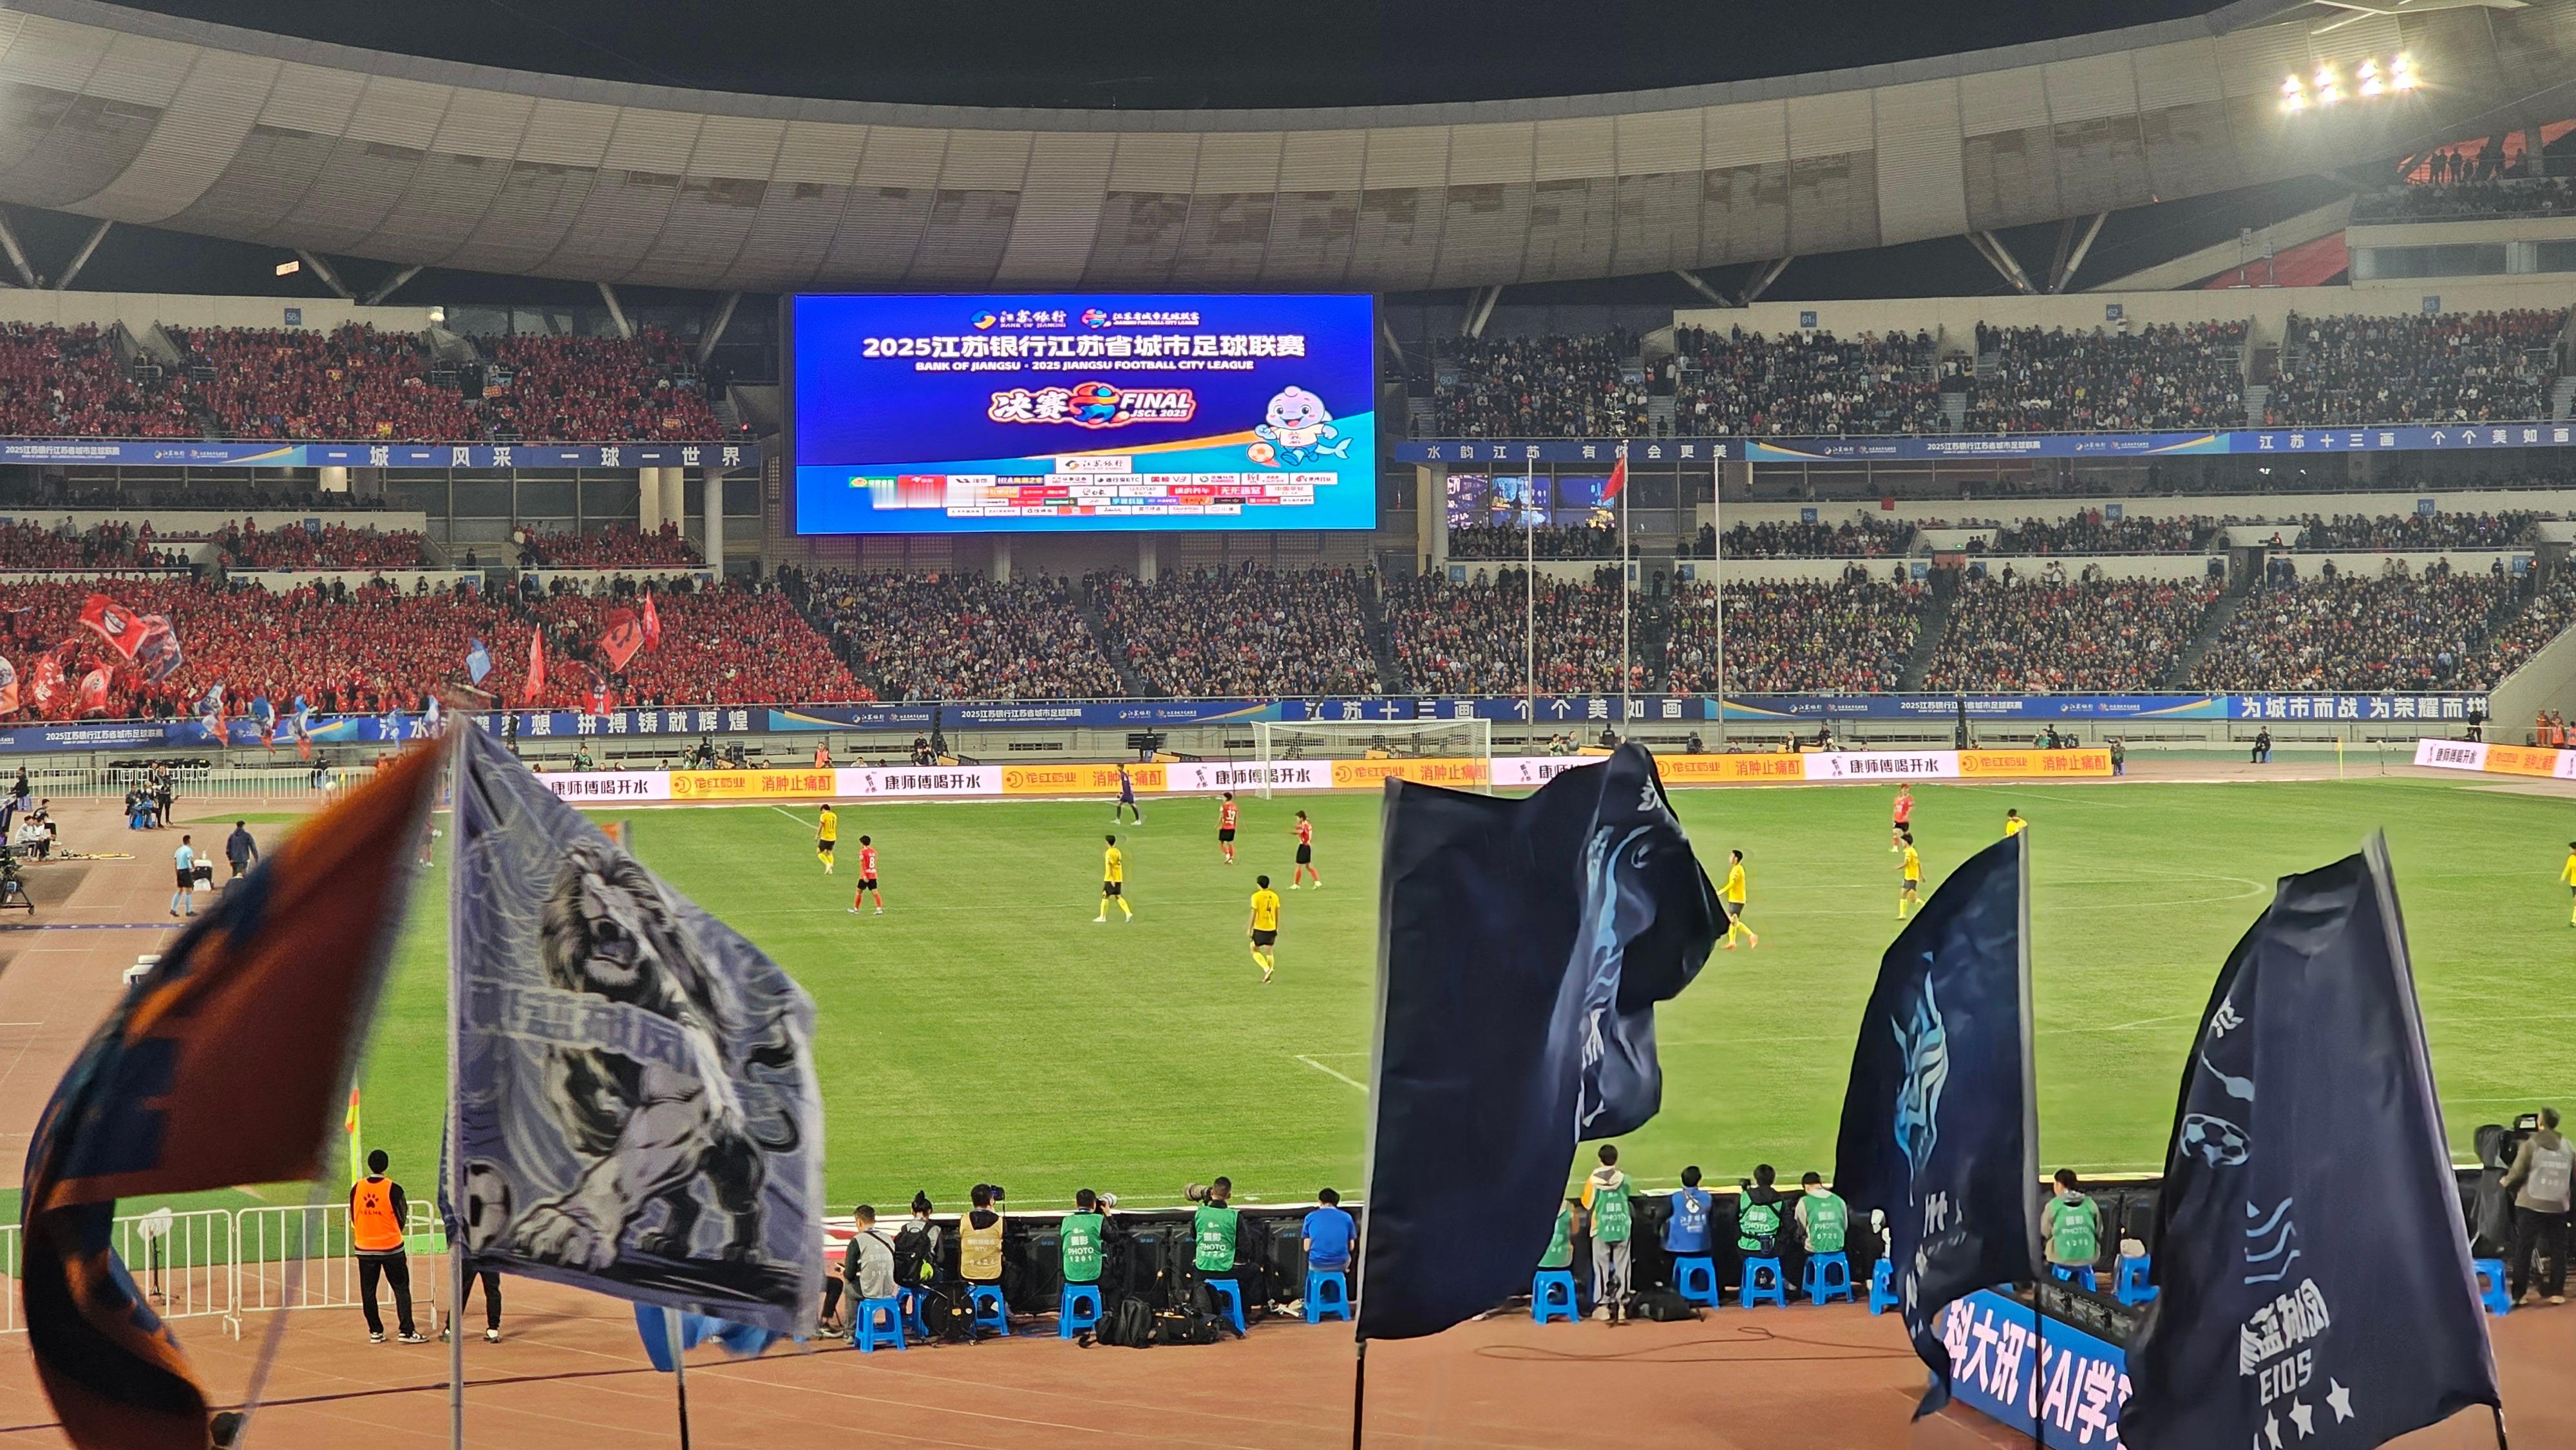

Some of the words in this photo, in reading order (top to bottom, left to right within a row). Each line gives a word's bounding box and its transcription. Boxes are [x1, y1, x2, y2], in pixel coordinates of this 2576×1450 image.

[863, 335, 1305, 358] 2025江苏银行江苏省城市足球联赛
[916, 362, 950, 370] BANK
[952, 362, 969, 370] OF
[971, 362, 1021, 372] JIANGSU
[1032, 361, 1061, 370] 2025
[1062, 361, 1113, 370] JIANGSU
[1114, 361, 1177, 370] FOOTBALL
[1177, 361, 1206, 370] CITY
[1207, 361, 1254, 370] LEAGUE
[994, 392, 1068, 419] 决赛
[1119, 393, 1189, 410] FINAL
[2259, 433, 2394, 449] 江苏十三画
[2431, 428, 2569, 445] 个个美如画
[328, 446, 511, 467] 一城一风采
[561, 447, 740, 467] 一球一世界
[1305, 701, 1474, 720] 江苏十三画
[1514, 699, 1683, 720] 个个美如画
[1900, 701, 2022, 710] 2025江苏银行江省城市足球联赛
[2242, 696, 2358, 719] 为城市而战
[2370, 697, 2488, 719] 为荣耀而拼
[577, 711, 748, 734] 拼搏铸就辉煌
[1736, 758, 1801, 777] 消肿止痛酊
[1850, 758, 1938, 773] 康师傅喝开水
[2043, 754, 2106, 771] 消肿止痛酊
[762, 775, 831, 792] 消肿止痛酊
[885, 773, 981, 790] 康师傅喝开水
[1216, 768, 1311, 785] 康师傅喝开水
[551, 779, 649, 796] 康师傅喝开水
[869, 857, 875, 869] 8
[1745, 1221, 1770, 1230] PHOTO
[1200, 1243, 1226, 1252] PHOTO
